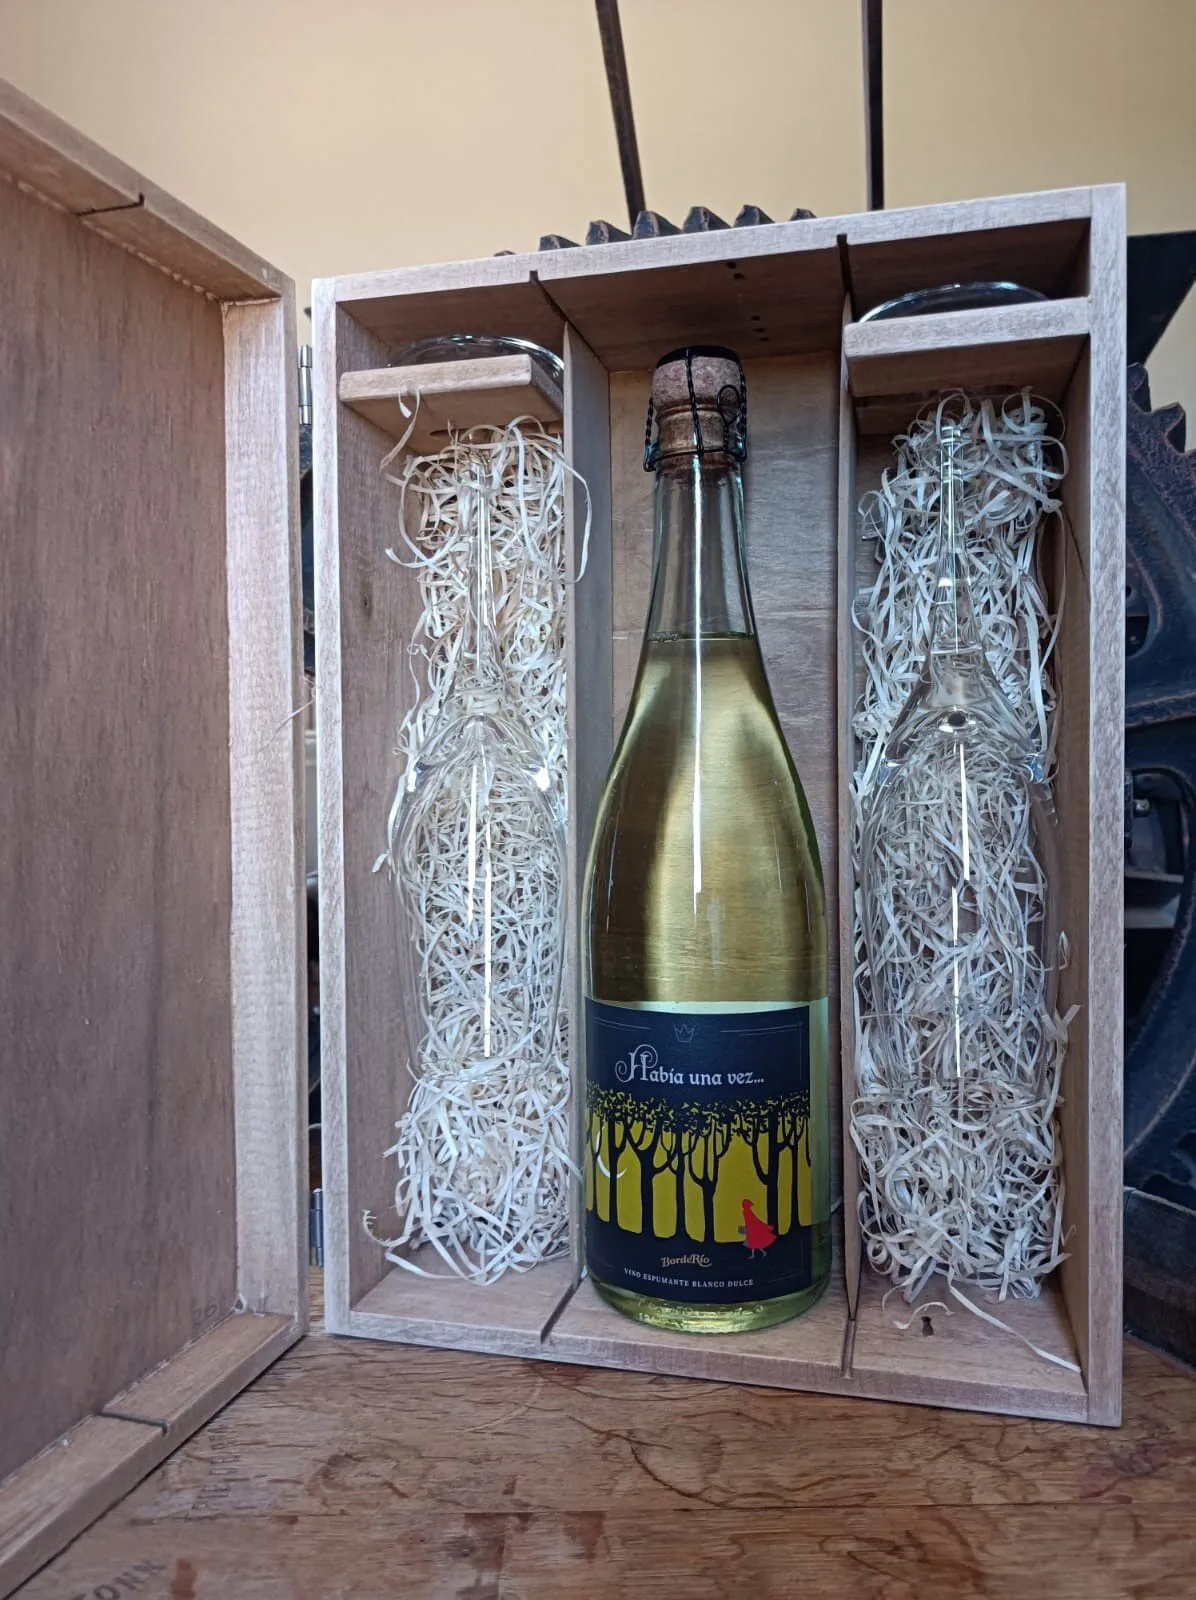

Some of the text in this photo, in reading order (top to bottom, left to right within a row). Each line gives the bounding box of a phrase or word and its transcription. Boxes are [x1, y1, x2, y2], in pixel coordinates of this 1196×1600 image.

[615, 1044, 764, 1086] Había una vez...
[624, 1267, 754, 1288] VINO ESPUMANTE BLANCO DULCE
